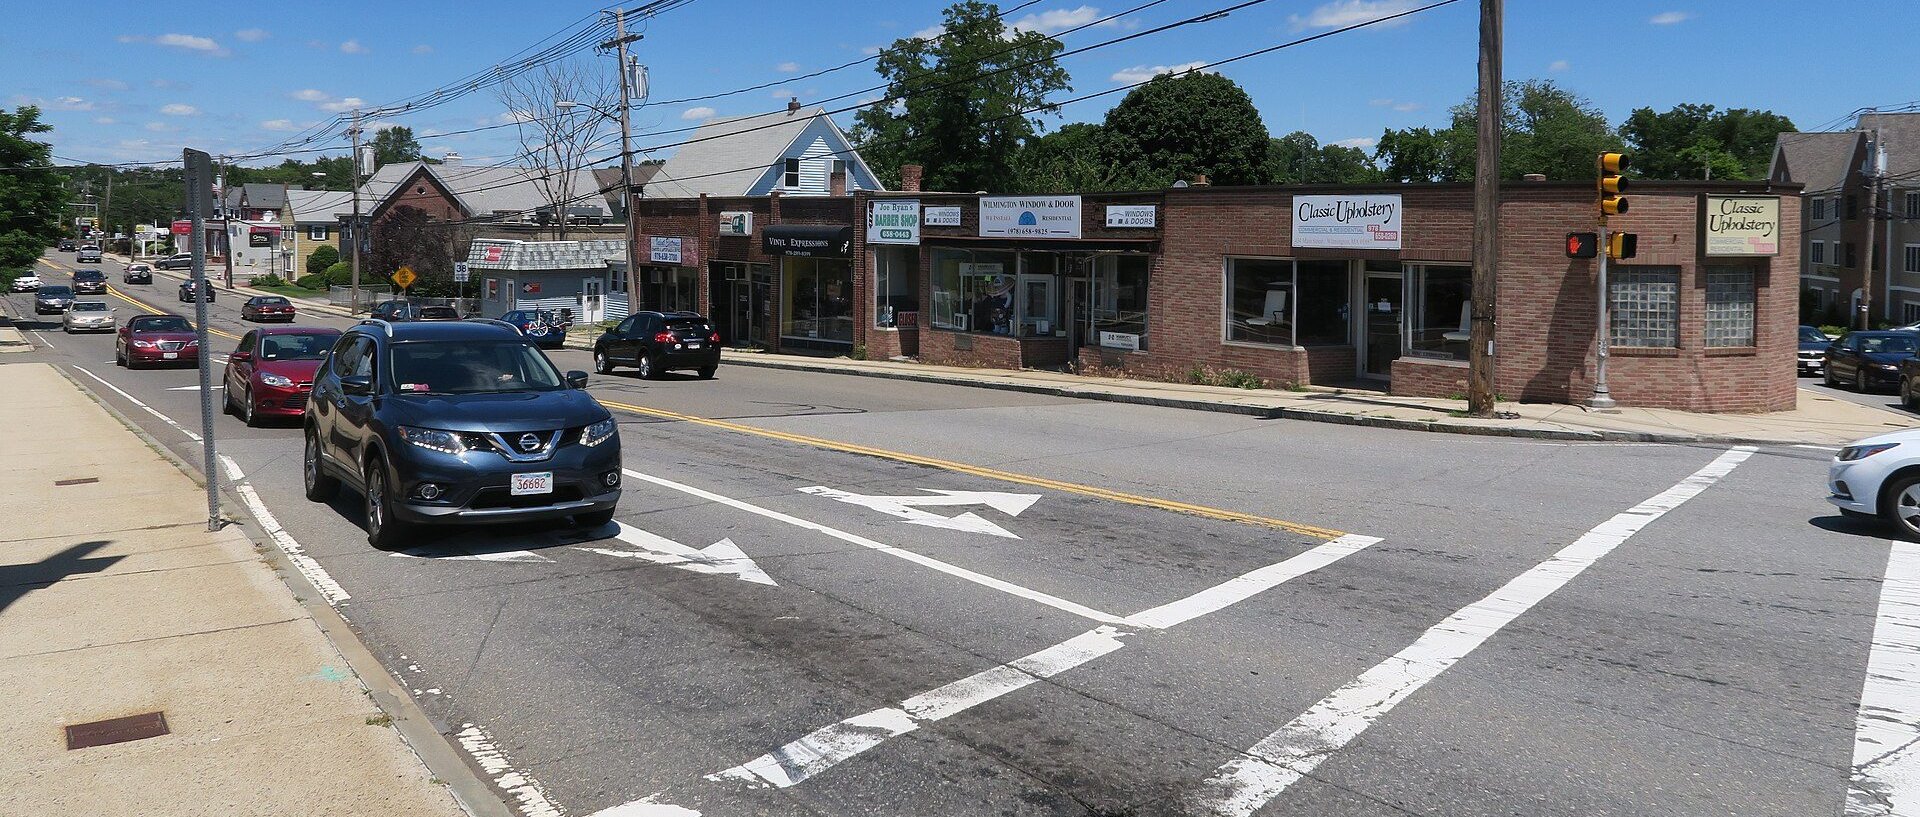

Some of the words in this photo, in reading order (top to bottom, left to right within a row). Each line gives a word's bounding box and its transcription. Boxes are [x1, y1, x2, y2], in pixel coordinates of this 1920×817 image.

[880, 203, 890, 211] Joe
[892, 203, 913, 212] Ryan's
[982, 200, 1017, 209] WILMINGTON
[1019, 200, 1046, 209] WINDOW
[1048, 200, 1053, 208] &
[1055, 200, 1074, 208] DOOR
[1721, 198, 1764, 215] Classic
[1124, 210, 1154, 218] WINDOWS
[1298, 202, 1335, 222] Classic
[1336, 200, 1395, 224] Upholstery
[875, 214, 899, 227] BARBER
[901, 214, 918, 227] SHOP
[1710, 214, 1775, 237] Upholstery
[769, 237, 786, 247] VINYL
[790, 238, 829, 248] EXPRESSIONS
[456, 264, 467, 273] 38
[516, 478, 546, 490] 36682
